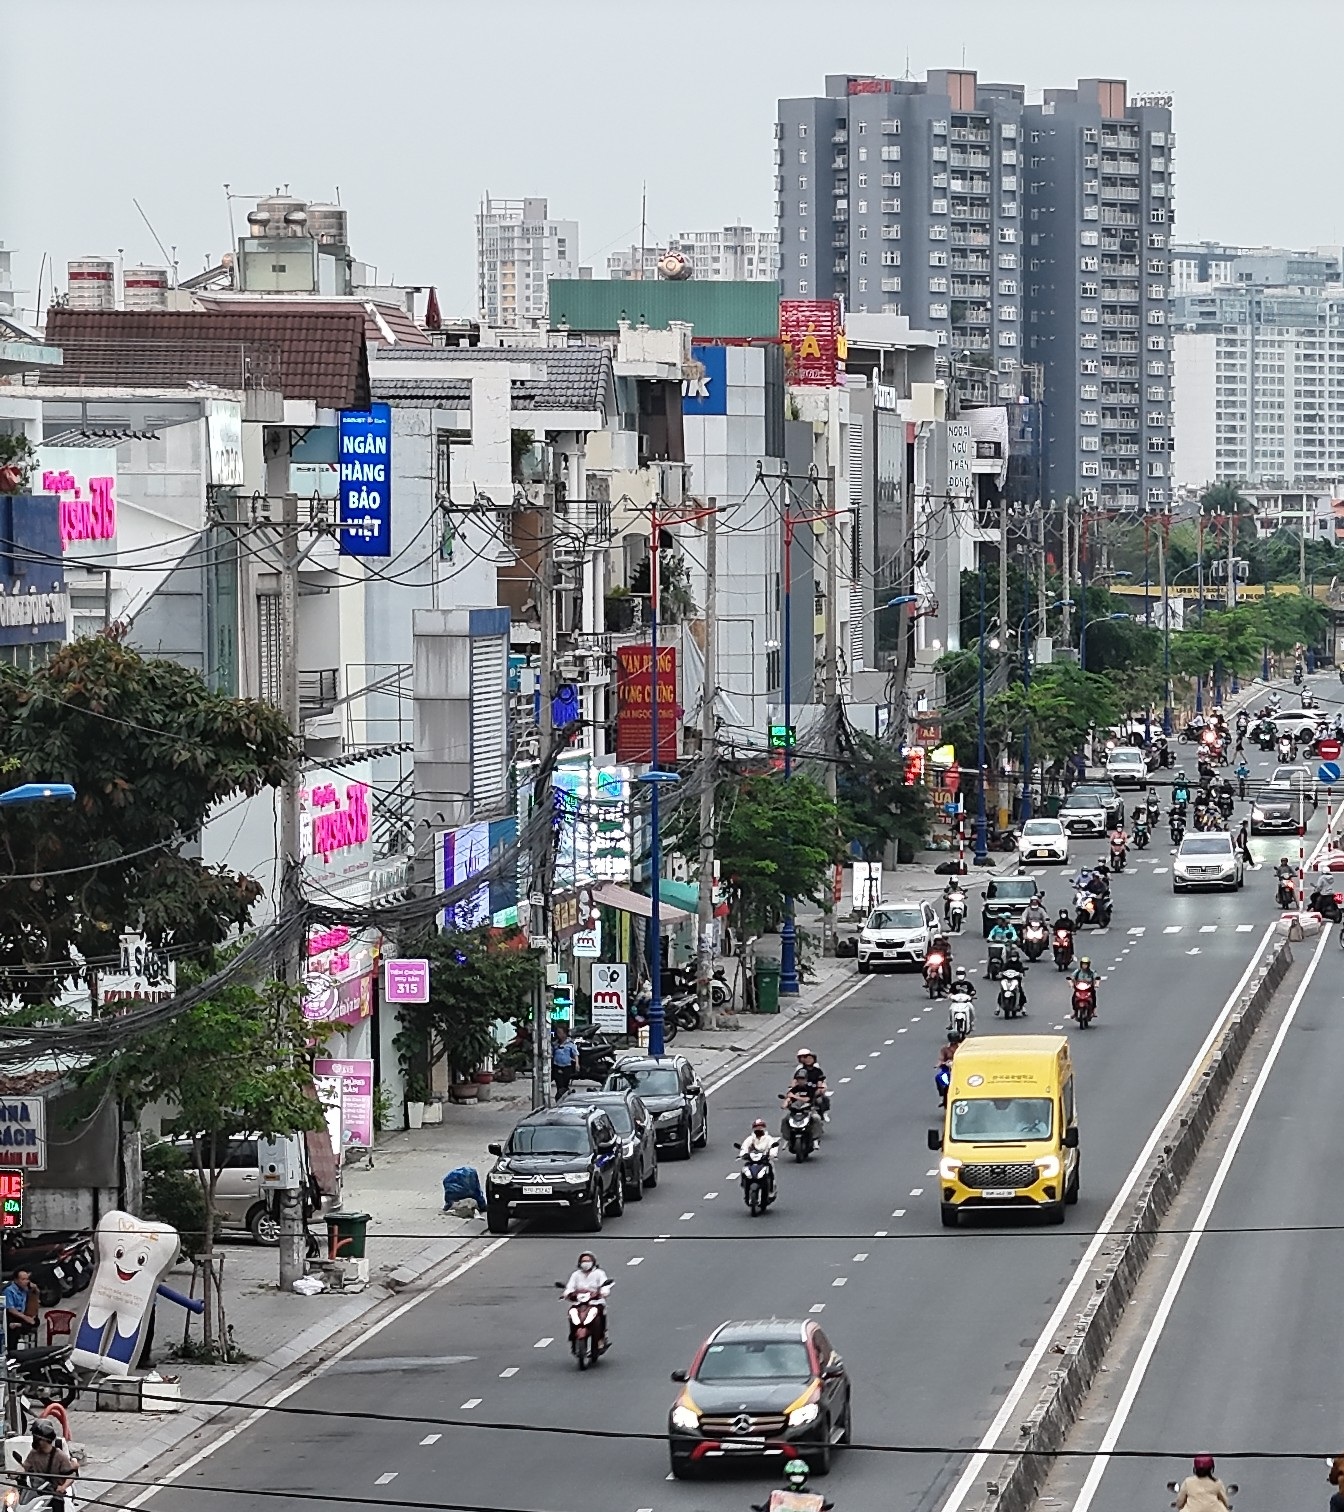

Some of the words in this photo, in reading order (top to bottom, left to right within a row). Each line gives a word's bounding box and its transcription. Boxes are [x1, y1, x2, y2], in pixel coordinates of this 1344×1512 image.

[343, 433, 387, 455] NGÂN
[341, 460, 385, 482] HÀNG
[348, 485, 381, 509] BẢO
[347, 515, 382, 541] VIỆT
[396, 983, 418, 994] 315
